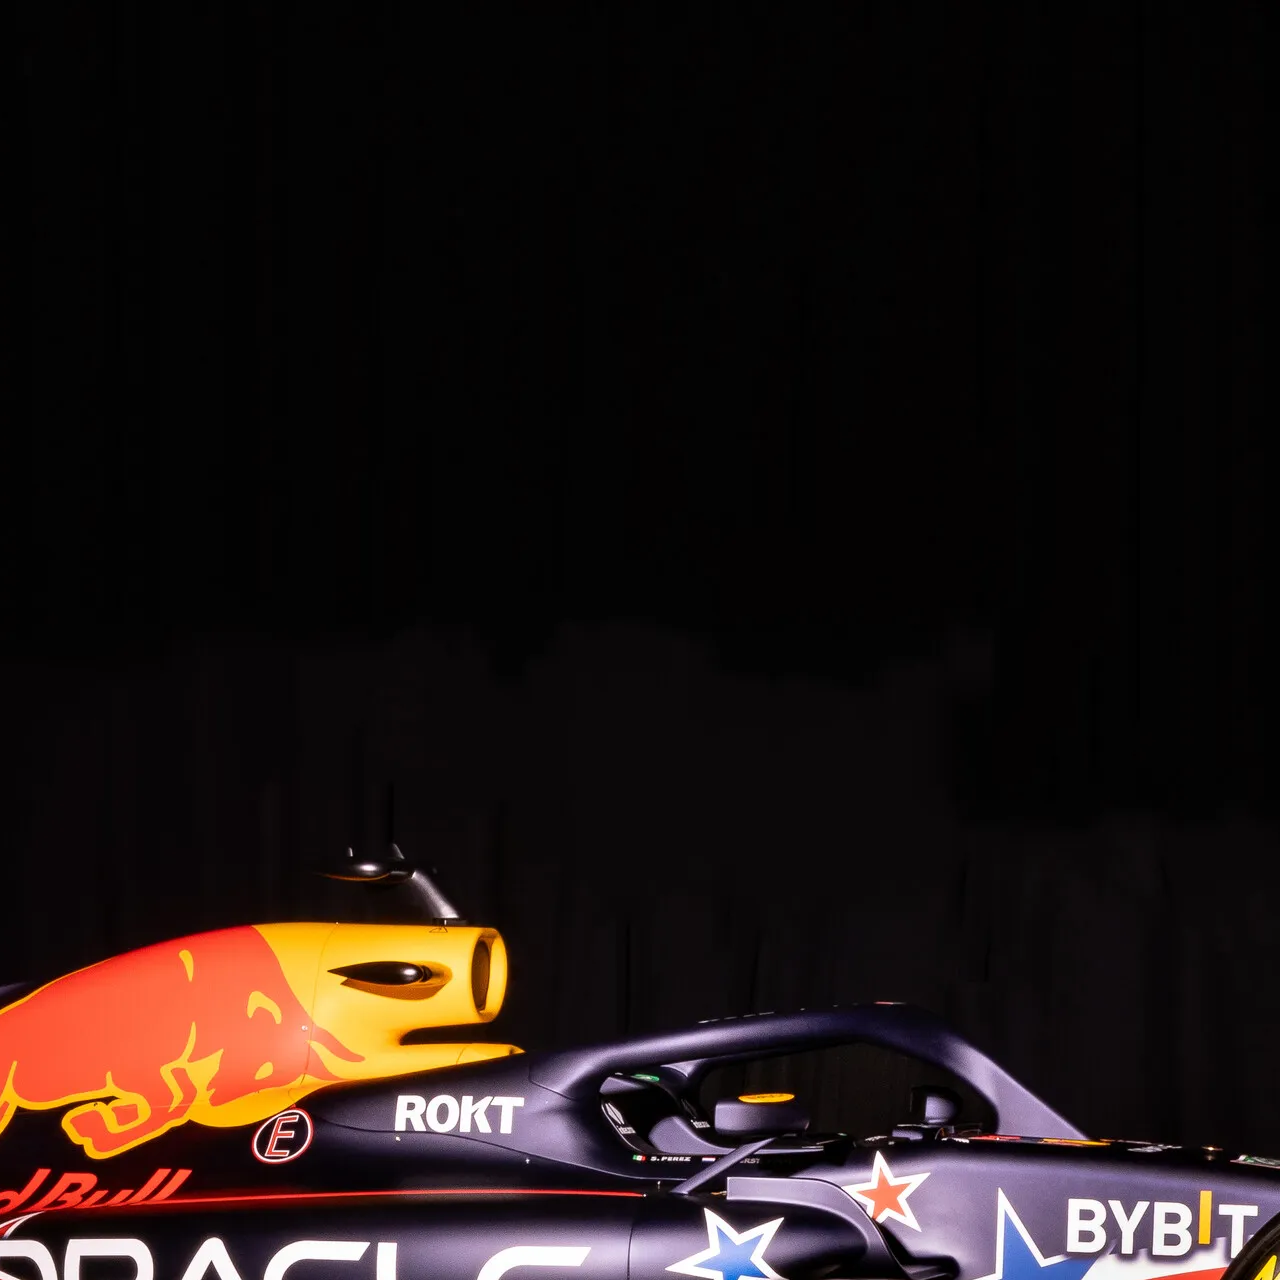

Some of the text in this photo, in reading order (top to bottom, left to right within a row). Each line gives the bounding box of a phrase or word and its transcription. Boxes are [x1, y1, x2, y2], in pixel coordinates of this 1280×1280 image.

[394, 1095, 525, 1134] ROKT
[39, 1169, 192, 1212] Bull
[1066, 1190, 1258, 1259] BYBIT
